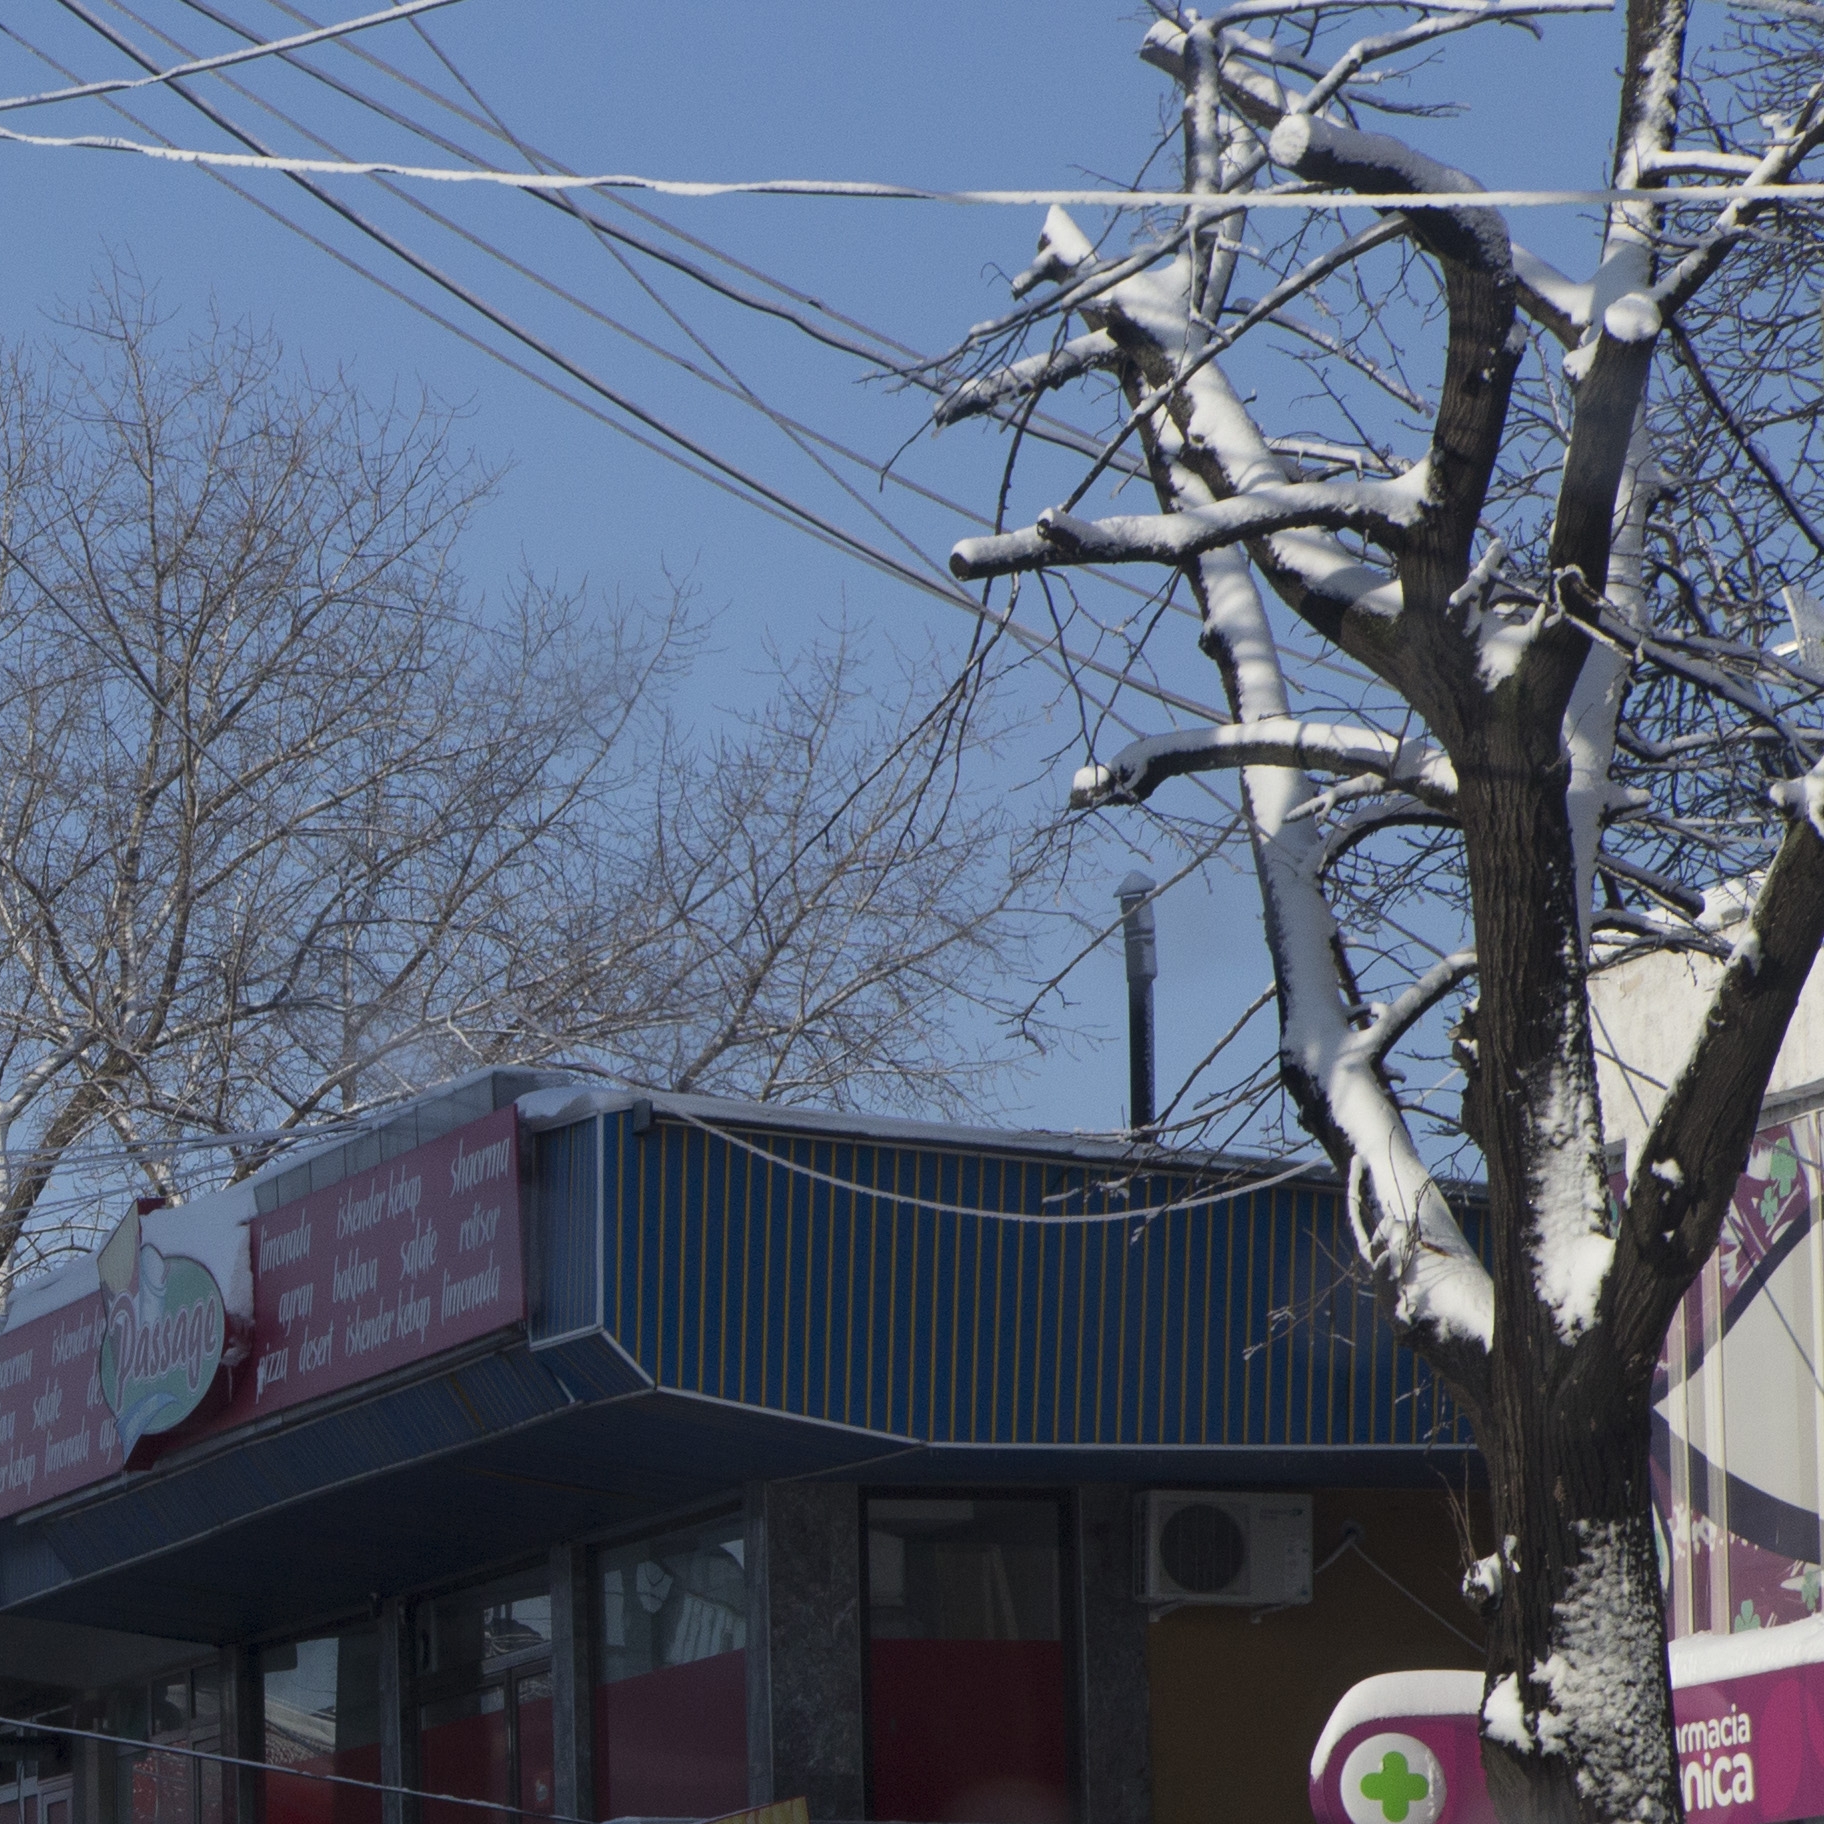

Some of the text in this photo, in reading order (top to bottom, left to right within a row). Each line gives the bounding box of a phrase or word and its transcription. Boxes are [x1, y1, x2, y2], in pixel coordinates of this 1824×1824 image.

[259, 1137, 510, 1278] limonada iskender kebap shaorma
[279, 1282, 314, 1337] ayran
[333, 1247, 378, 1304] baklava
[400, 1217, 438, 1281] salate
[52, 1312, 92, 1367] iskender
[108, 1289, 217, 1417] Passage
[256, 1249, 501, 1404] pizza desert iskender kebap limonada
[32, 1376, 63, 1431] salate
[8, 1443, 36, 1496] kebap
[44, 1415, 89, 1478] limonada
[1676, 1703, 1751, 1753] rmacia
[1680, 1752, 1755, 1812] nica
